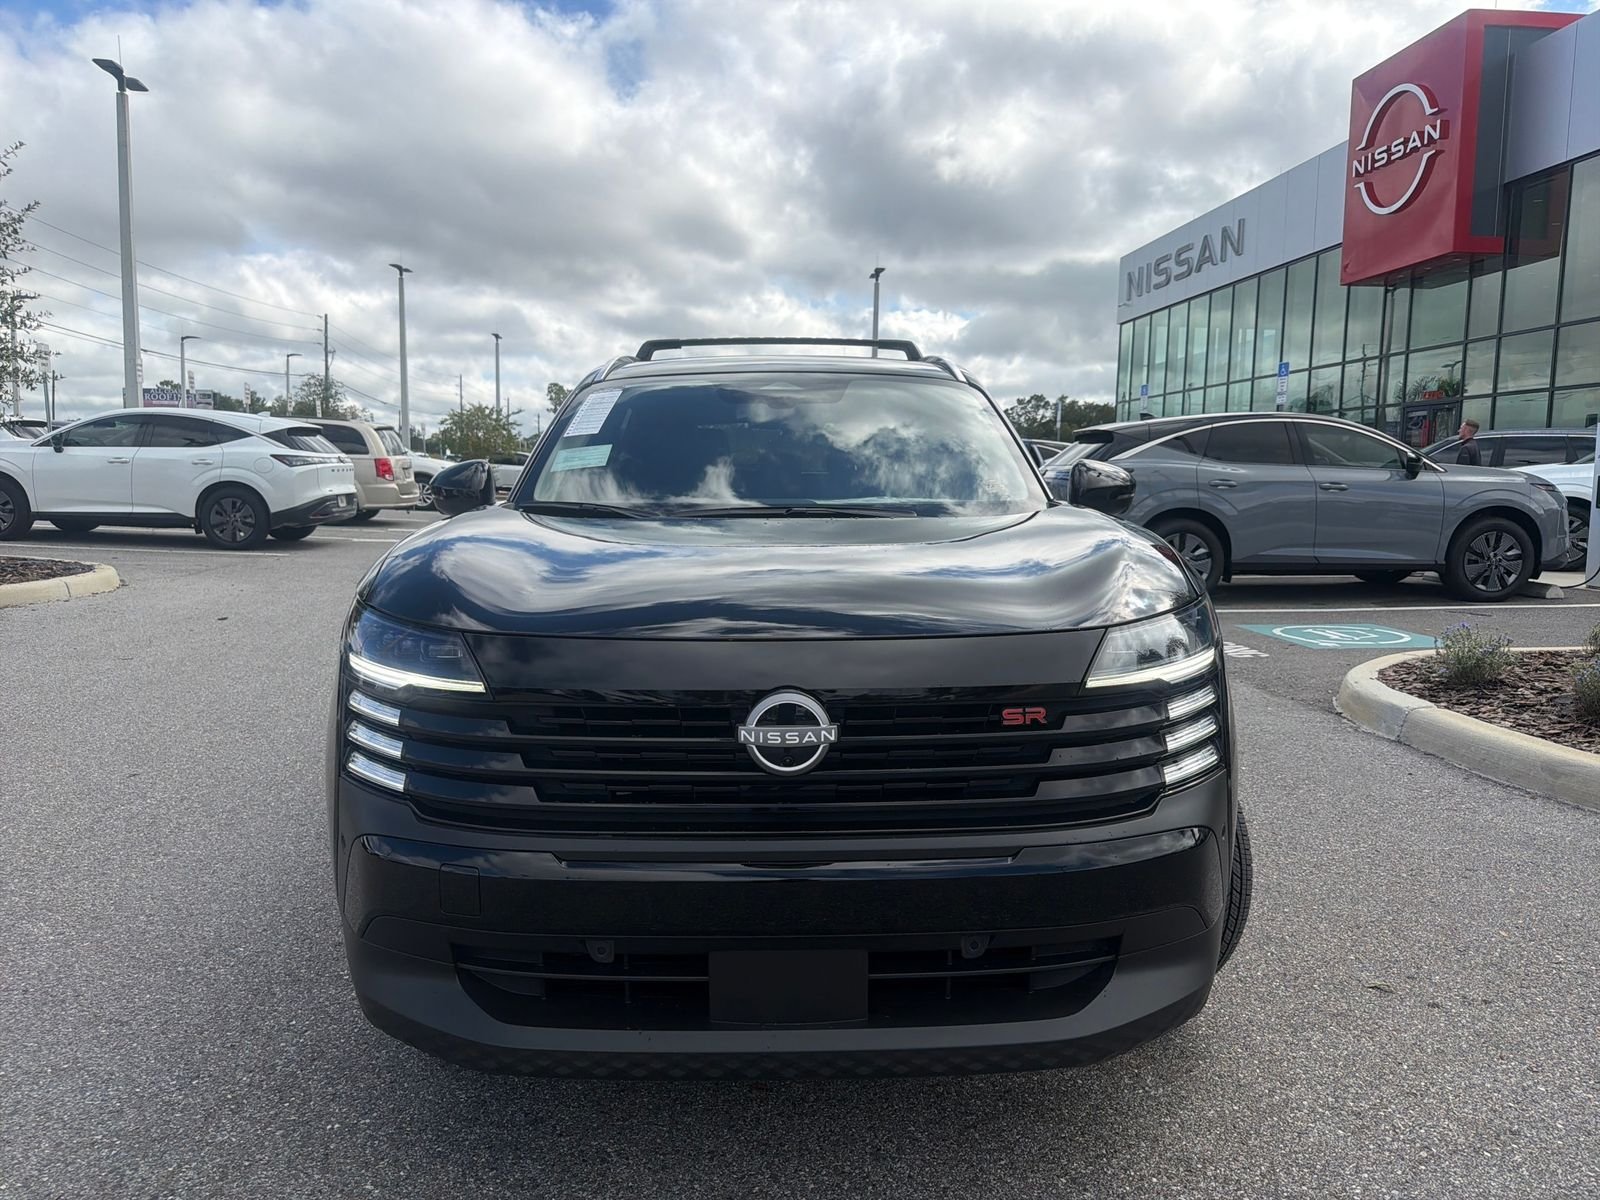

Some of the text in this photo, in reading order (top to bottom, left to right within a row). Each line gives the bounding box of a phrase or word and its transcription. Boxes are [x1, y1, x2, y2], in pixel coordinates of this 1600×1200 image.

[1352, 118, 1441, 178] NISSAN
[1126, 218, 1246, 301] NISSAN
[1002, 707, 1047, 725] SR
[740, 729, 835, 744] NISSAN
